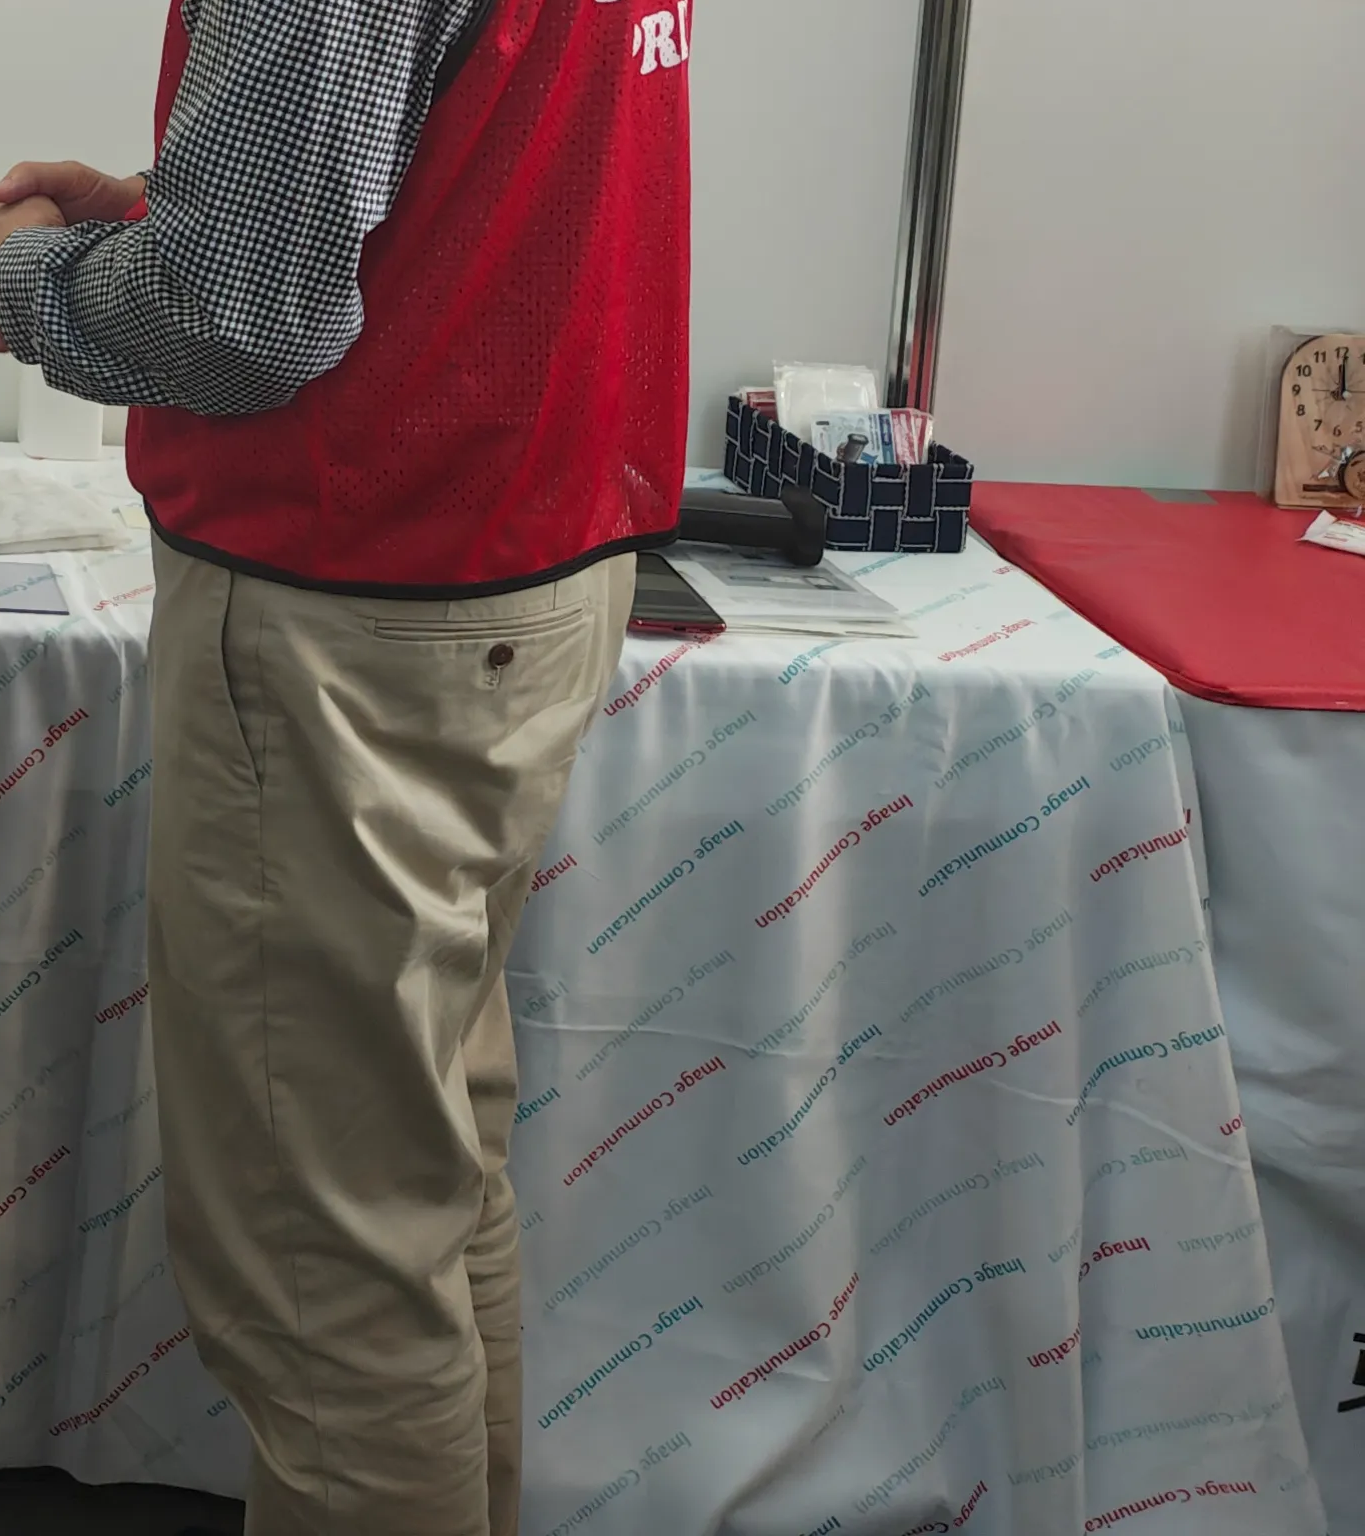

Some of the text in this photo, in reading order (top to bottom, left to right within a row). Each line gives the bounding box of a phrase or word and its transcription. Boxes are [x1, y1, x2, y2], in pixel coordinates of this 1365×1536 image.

[1314, 351, 1327, 363] 11
[1335, 347, 1349, 359] 12
[1296, 364, 1312, 378] 10
[1292, 384, 1301, 396] 9
[1296, 404, 1306, 416] 8
[1314, 419, 1323, 431] 7
[1333, 424, 1342, 437] 6
[754, 793, 916, 931] Image Communication
[536, 1295, 705, 1432] Image Communication
